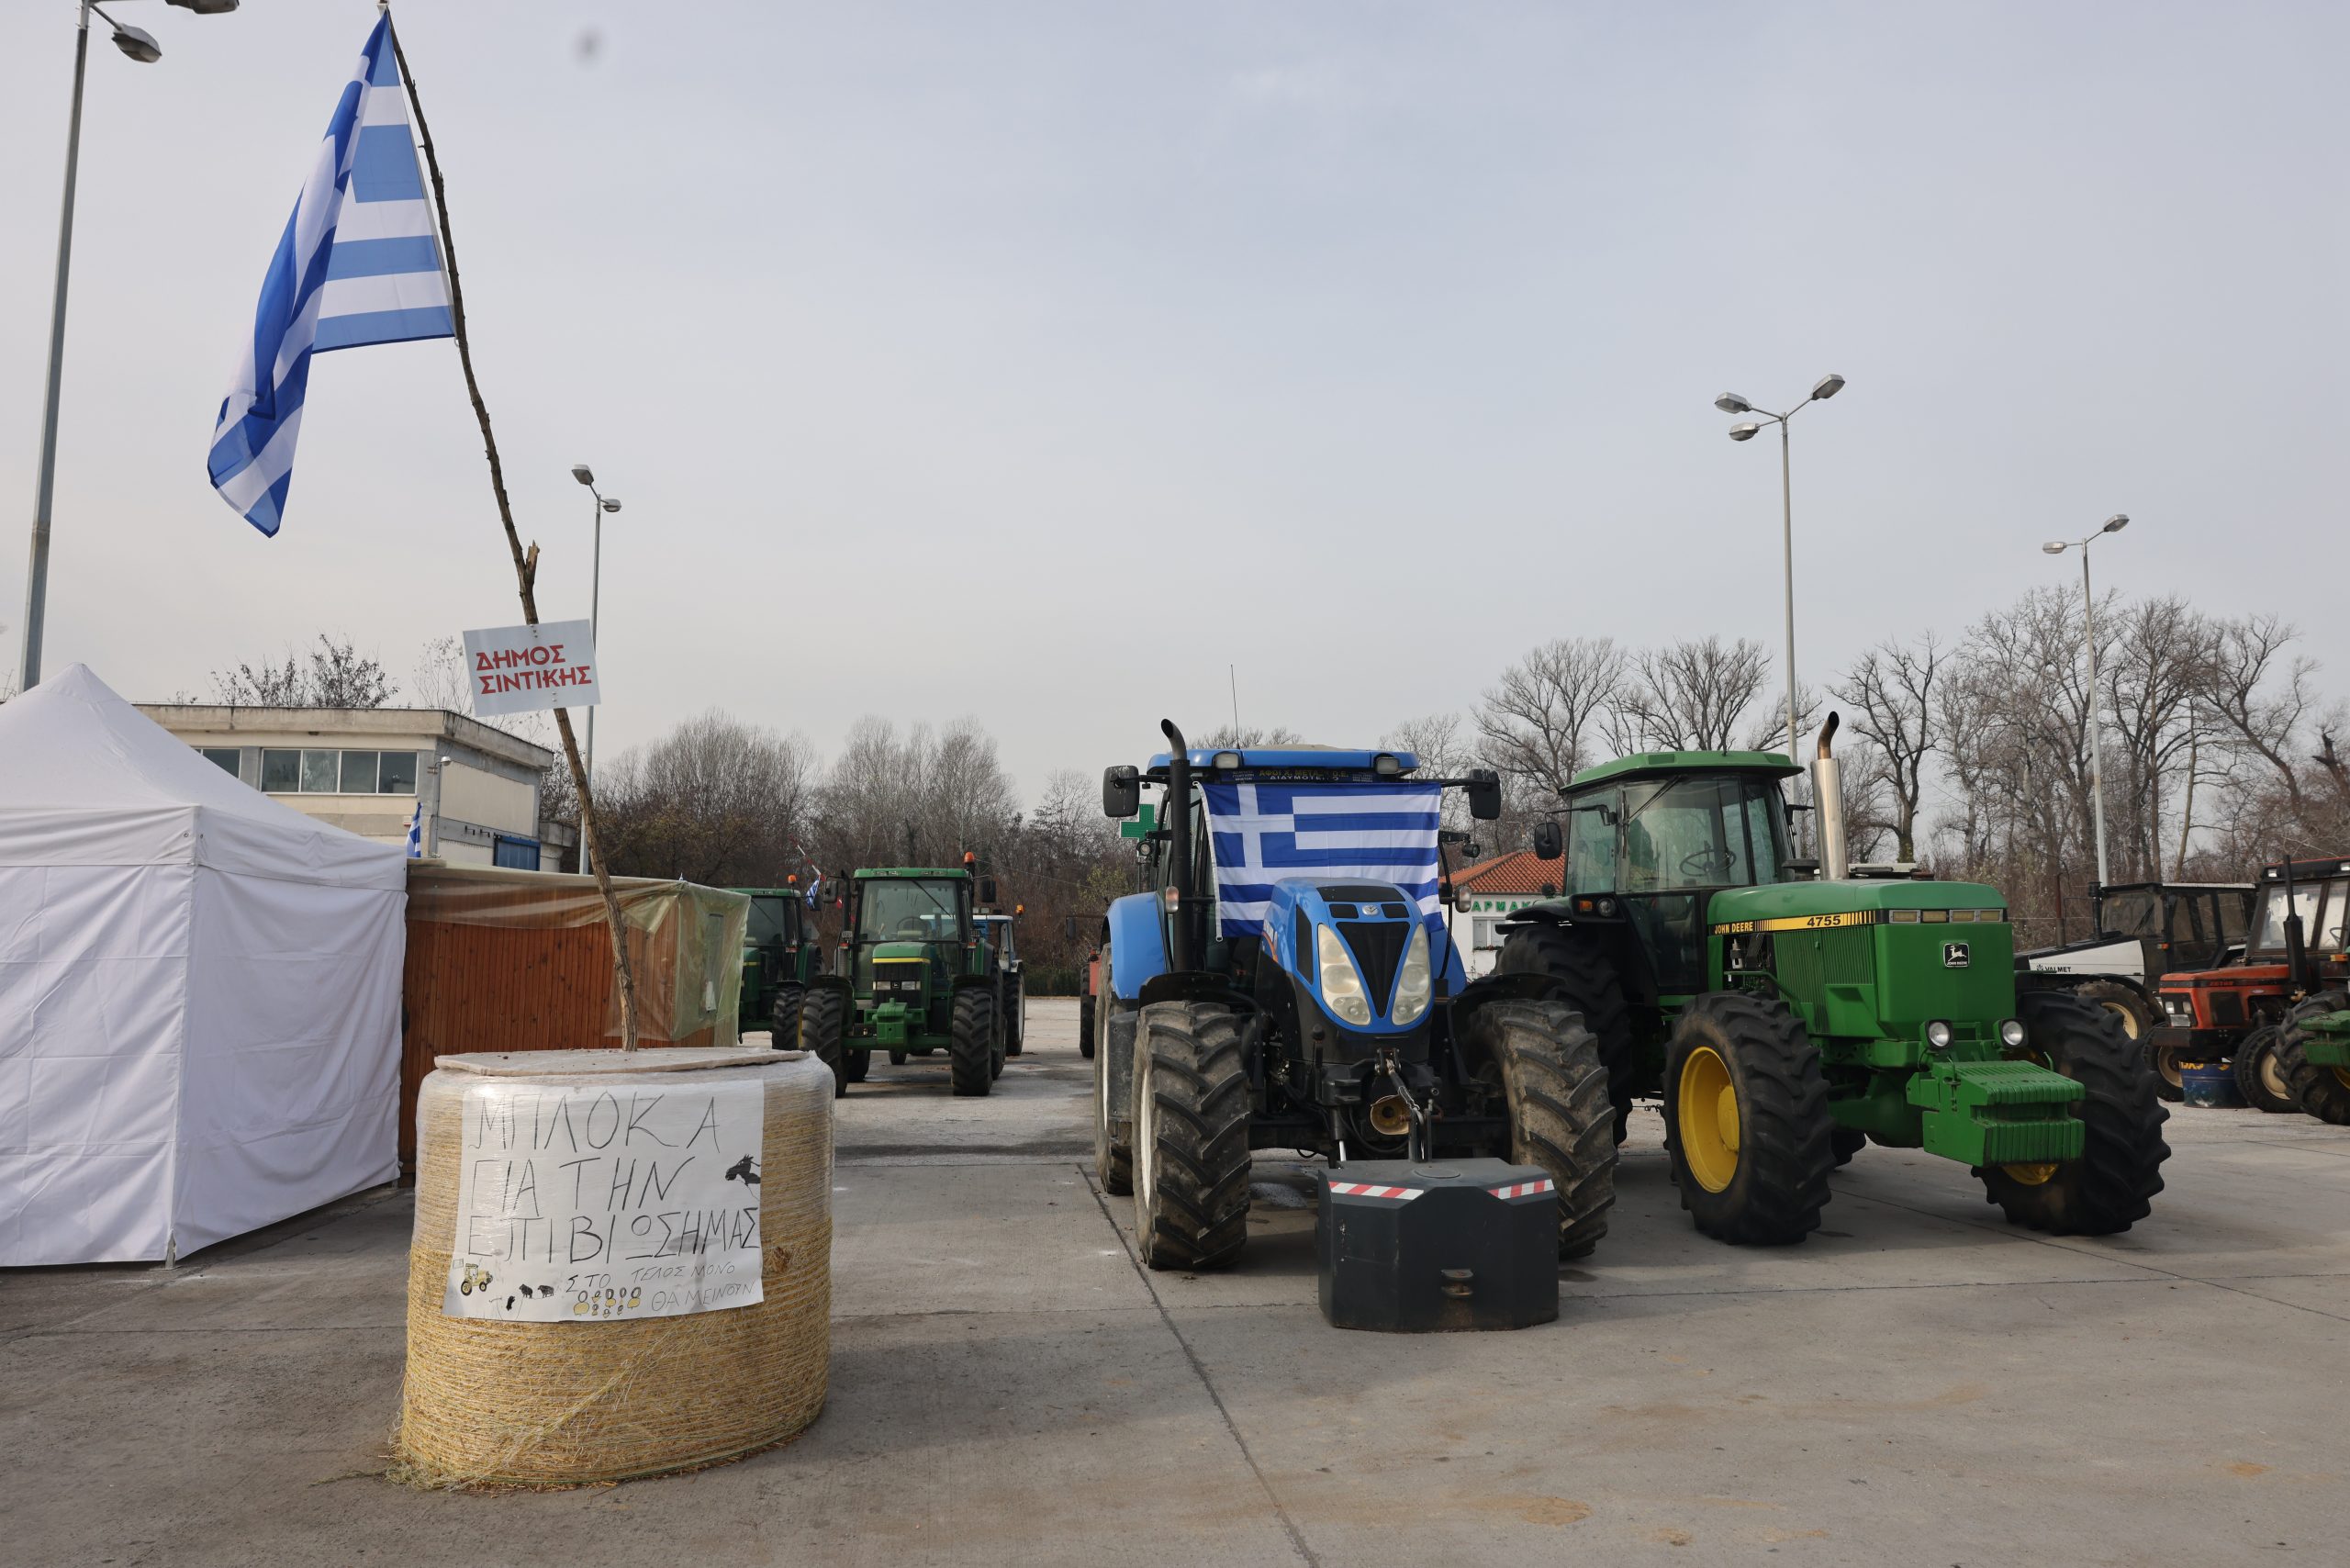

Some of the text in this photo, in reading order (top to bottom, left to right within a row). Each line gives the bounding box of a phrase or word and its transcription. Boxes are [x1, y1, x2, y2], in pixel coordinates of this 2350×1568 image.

[476, 644, 565, 671] ΔΗΜΟΣ
[478, 666, 592, 695] ΣΙΝΤΙΚΗΣ
[1714, 921, 1753, 935] JOHN DEERE
[1807, 915, 1841, 927] 4755
[467, 1090, 721, 1154] ΜΠΛΟΚΑ
[470, 1156, 696, 1216] ΓΙΑ ΤΗΝ
[565, 1261, 735, 1293] ΣΤΟ ΤΕΛΟΣ ΜΟΝΟ
[651, 1291, 679, 1312] ΘΑ
